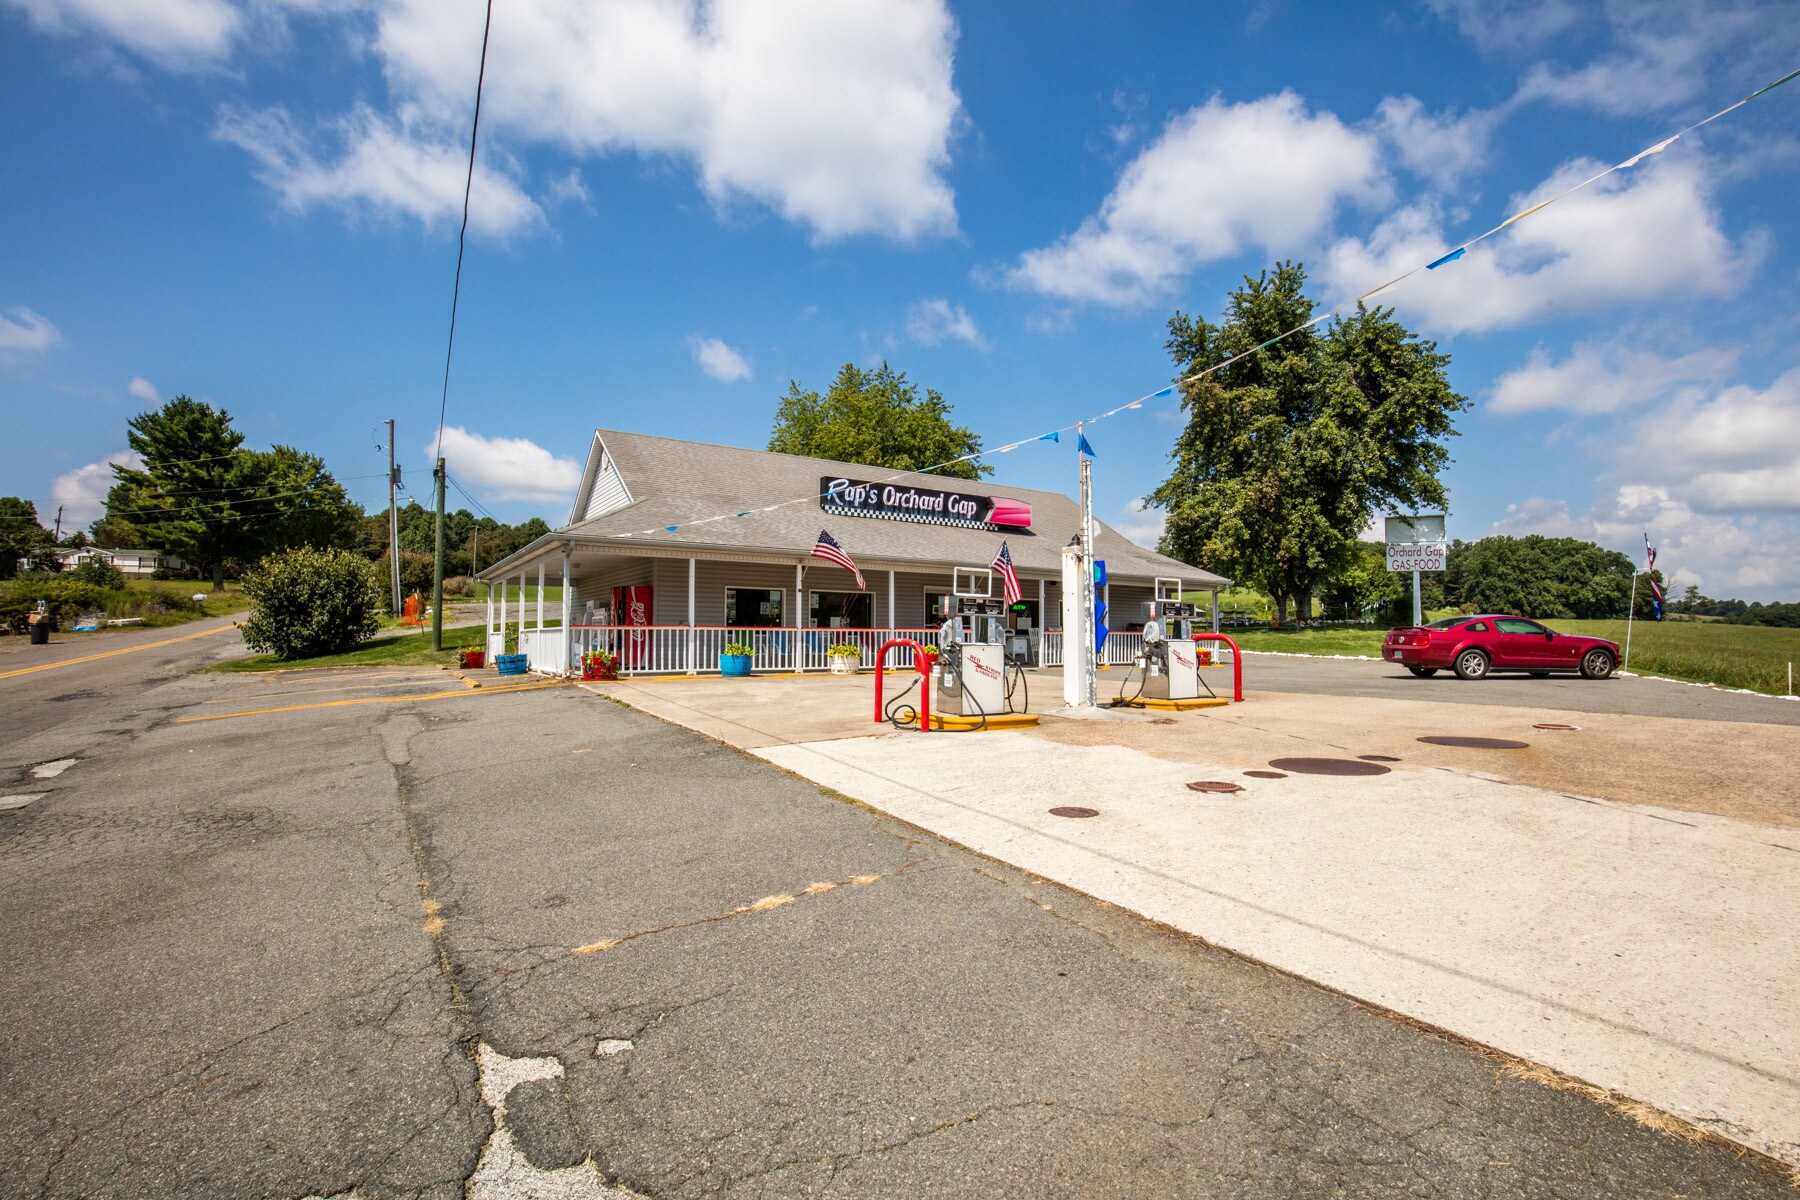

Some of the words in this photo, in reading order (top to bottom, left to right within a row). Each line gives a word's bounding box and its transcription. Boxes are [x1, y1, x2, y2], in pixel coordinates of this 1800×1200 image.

[828, 478, 878, 506] Rap's
[882, 486, 945, 512] Orchard
[948, 494, 977, 519] Gap
[1388, 546, 1422, 557] Orchard
[1425, 545, 1444, 558] Gap
[1392, 559, 1441, 571] GAS-FOOD
